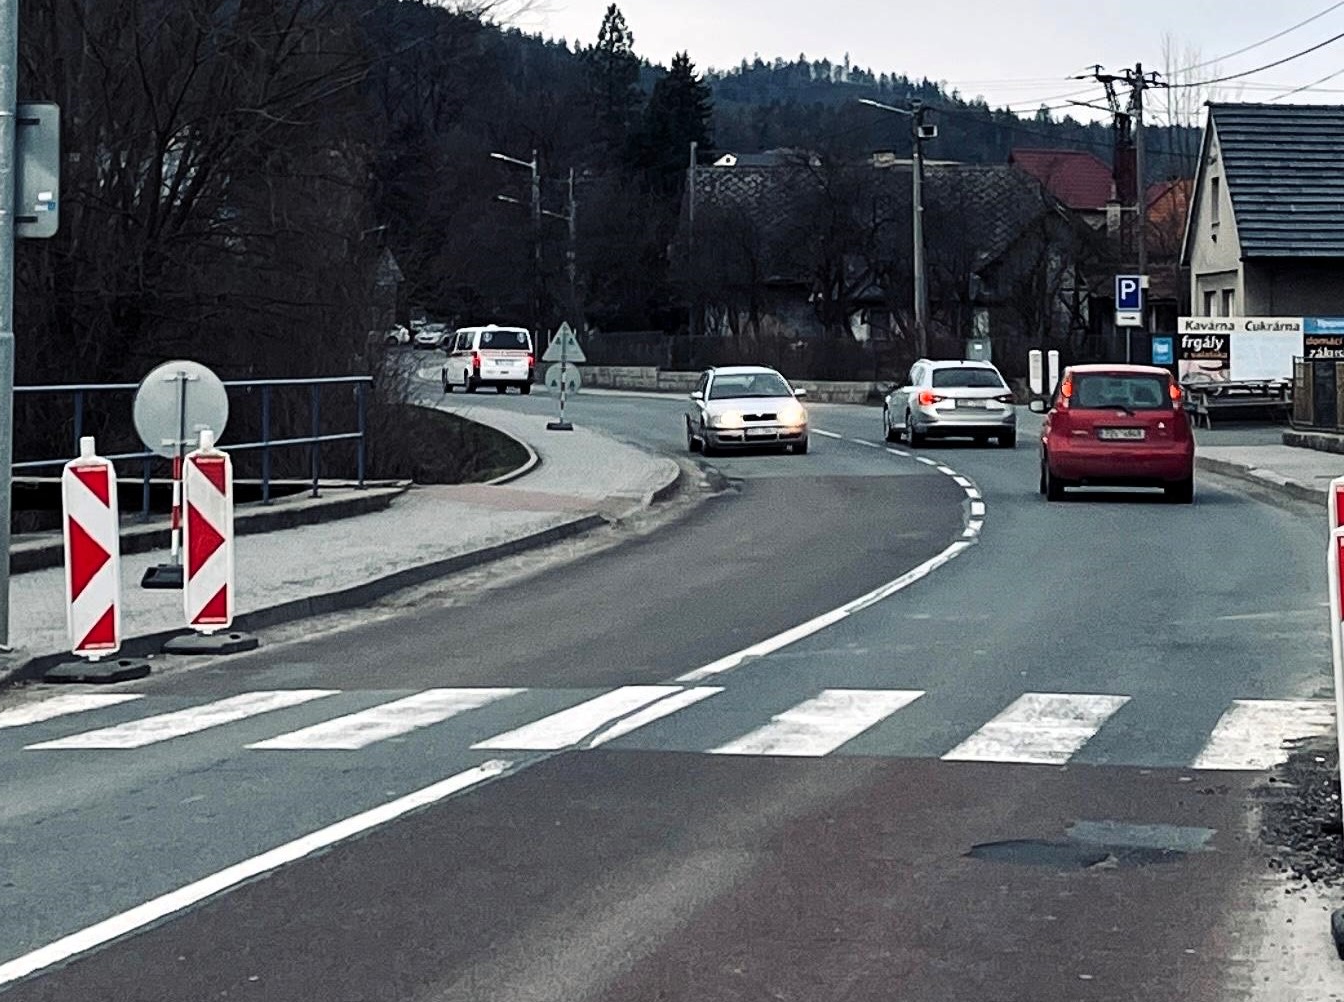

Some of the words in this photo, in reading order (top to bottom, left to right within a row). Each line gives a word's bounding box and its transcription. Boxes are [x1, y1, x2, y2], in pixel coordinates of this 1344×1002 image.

[1121, 280, 1136, 300] P
[1244, 320, 1300, 332] Cukrárna
[1181, 334, 1225, 352] frgály
